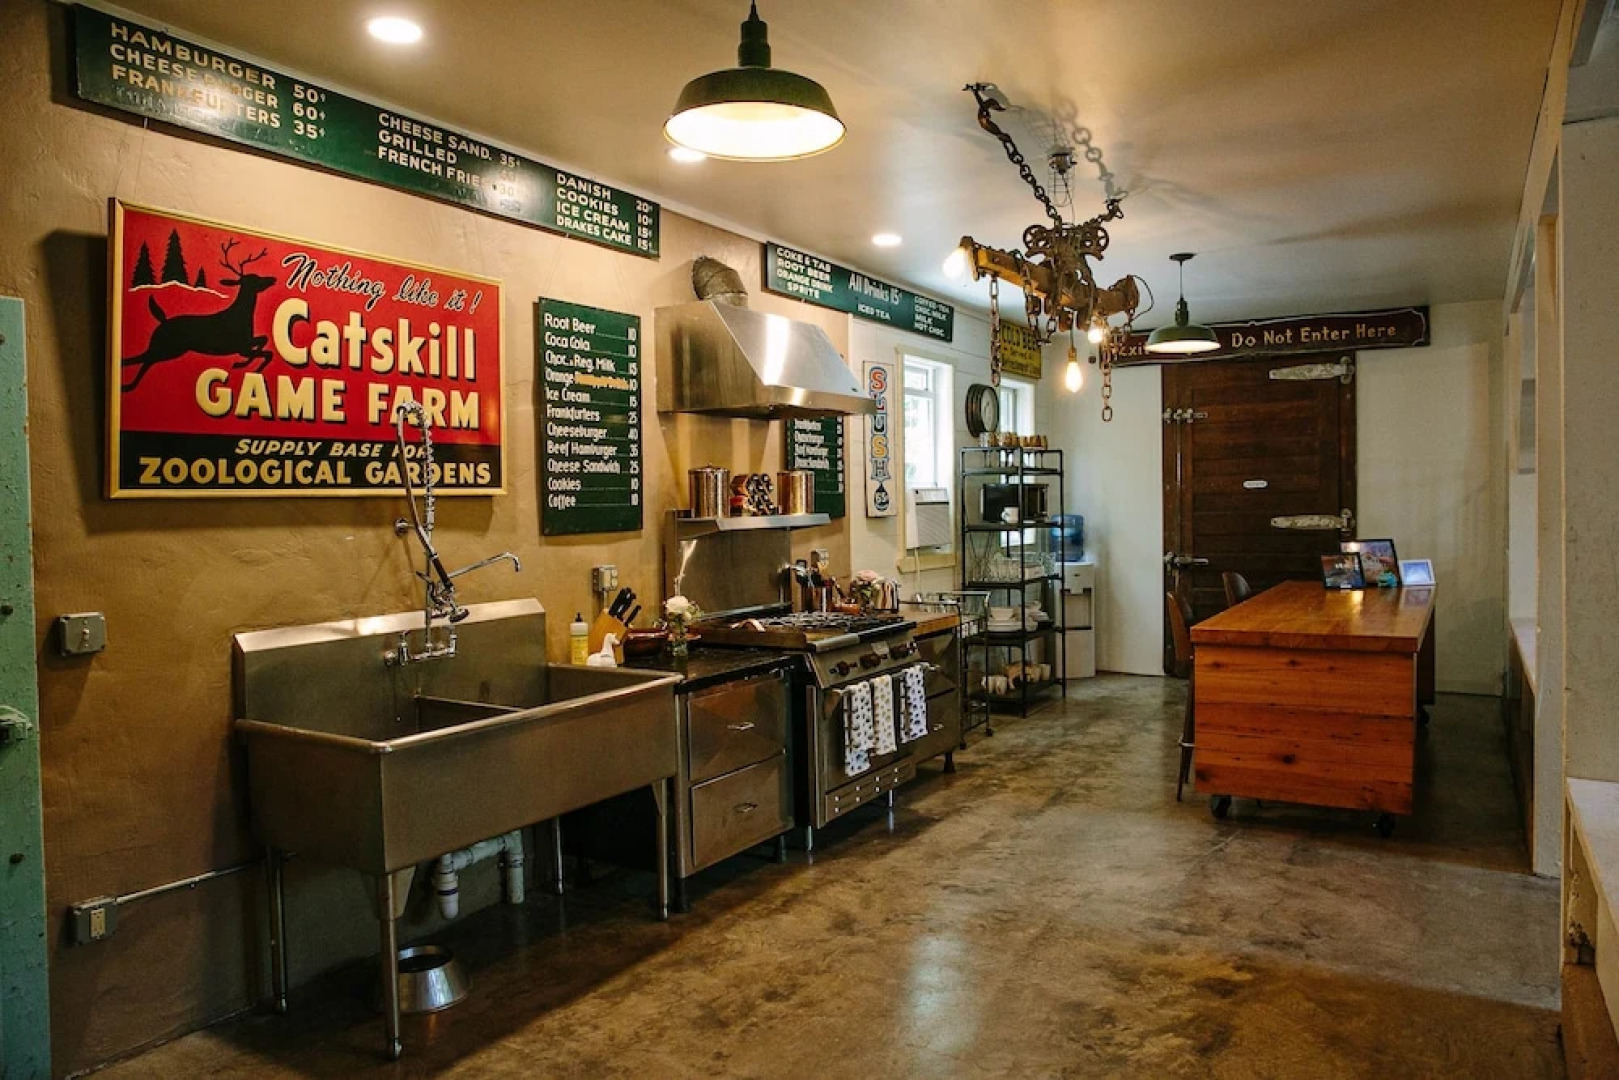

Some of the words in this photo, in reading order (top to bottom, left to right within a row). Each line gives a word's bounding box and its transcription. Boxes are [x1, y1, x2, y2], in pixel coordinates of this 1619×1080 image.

[110, 22, 276, 90] HAMBURGER
[112, 65, 281, 129] FRANKFUTERS
[378, 113, 443, 145] CHEESE
[449, 135, 492, 161] SAND.
[378, 130, 457, 164] GRILLED
[378, 146, 442, 176] FRENCH
[557, 173, 611, 200] DANISH
[556, 188, 618, 216] COOKIES
[557, 201, 580, 217] ICE
[583, 210, 630, 232] CREAM
[557, 215, 600, 236] DRAKES
[602, 228, 632, 245] CAKE
[777, 247, 803, 263] COKE
[777, 258, 805, 273] ROOT
[808, 267, 830, 282] BEER
[777, 269, 810, 286] ORANGE
[282, 253, 385, 311] Nothing
[395, 276, 438, 308] like
[787, 281, 820, 299] SPRITE
[848, 272, 862, 293] All
[858, 303, 874, 315] ICED
[876, 309, 891, 320] TEA
[544, 312, 569, 330] Root
[572, 318, 596, 334] Beer
[272, 297, 477, 381] Catskill
[545, 331, 568, 348] Coca
[570, 335, 590, 351] Cola
[1231, 333, 1257, 348] Do
[1263, 329, 1293, 345] Not
[1301, 327, 1350, 343] Enter
[1356, 323, 1397, 339] Here
[595, 357, 616, 372] Milk
[196, 368, 347, 425] GAME
[367, 382, 480, 430] FARM
[545, 386, 559, 401] Ice
[561, 387, 590, 403] Cream
[546, 404, 600, 421] Frankfurters
[546, 421, 607, 442] Cheeseburger
[235, 438, 322, 457] SUPPLY
[329, 441, 382, 458] BASE
[546, 440, 569, 457] Beef
[571, 441, 617, 460] Hamburger
[138, 456, 351, 485] ZOOLOGICAL
[365, 461, 491, 485] GARDENS
[548, 458, 580, 473] Cheese
[582, 460, 620, 473] Sandwich
[548, 477, 582, 492] Cookies
[548, 493, 577, 510] Coffee
